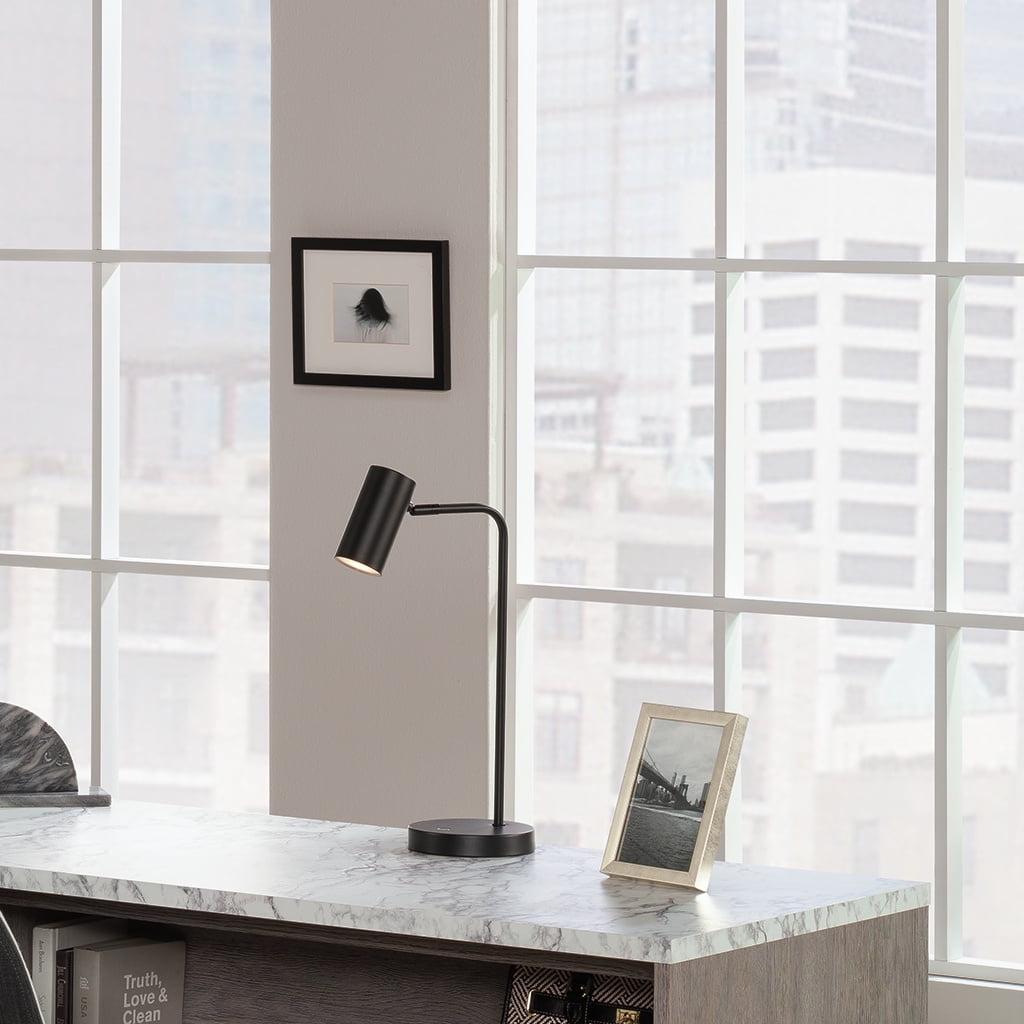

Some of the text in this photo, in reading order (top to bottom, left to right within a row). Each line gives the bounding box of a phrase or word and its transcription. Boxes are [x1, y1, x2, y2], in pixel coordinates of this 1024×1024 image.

[124, 971, 162, 990] Truth,
[80, 997, 88, 1018] USA
[123, 987, 168, 1008] Love &
